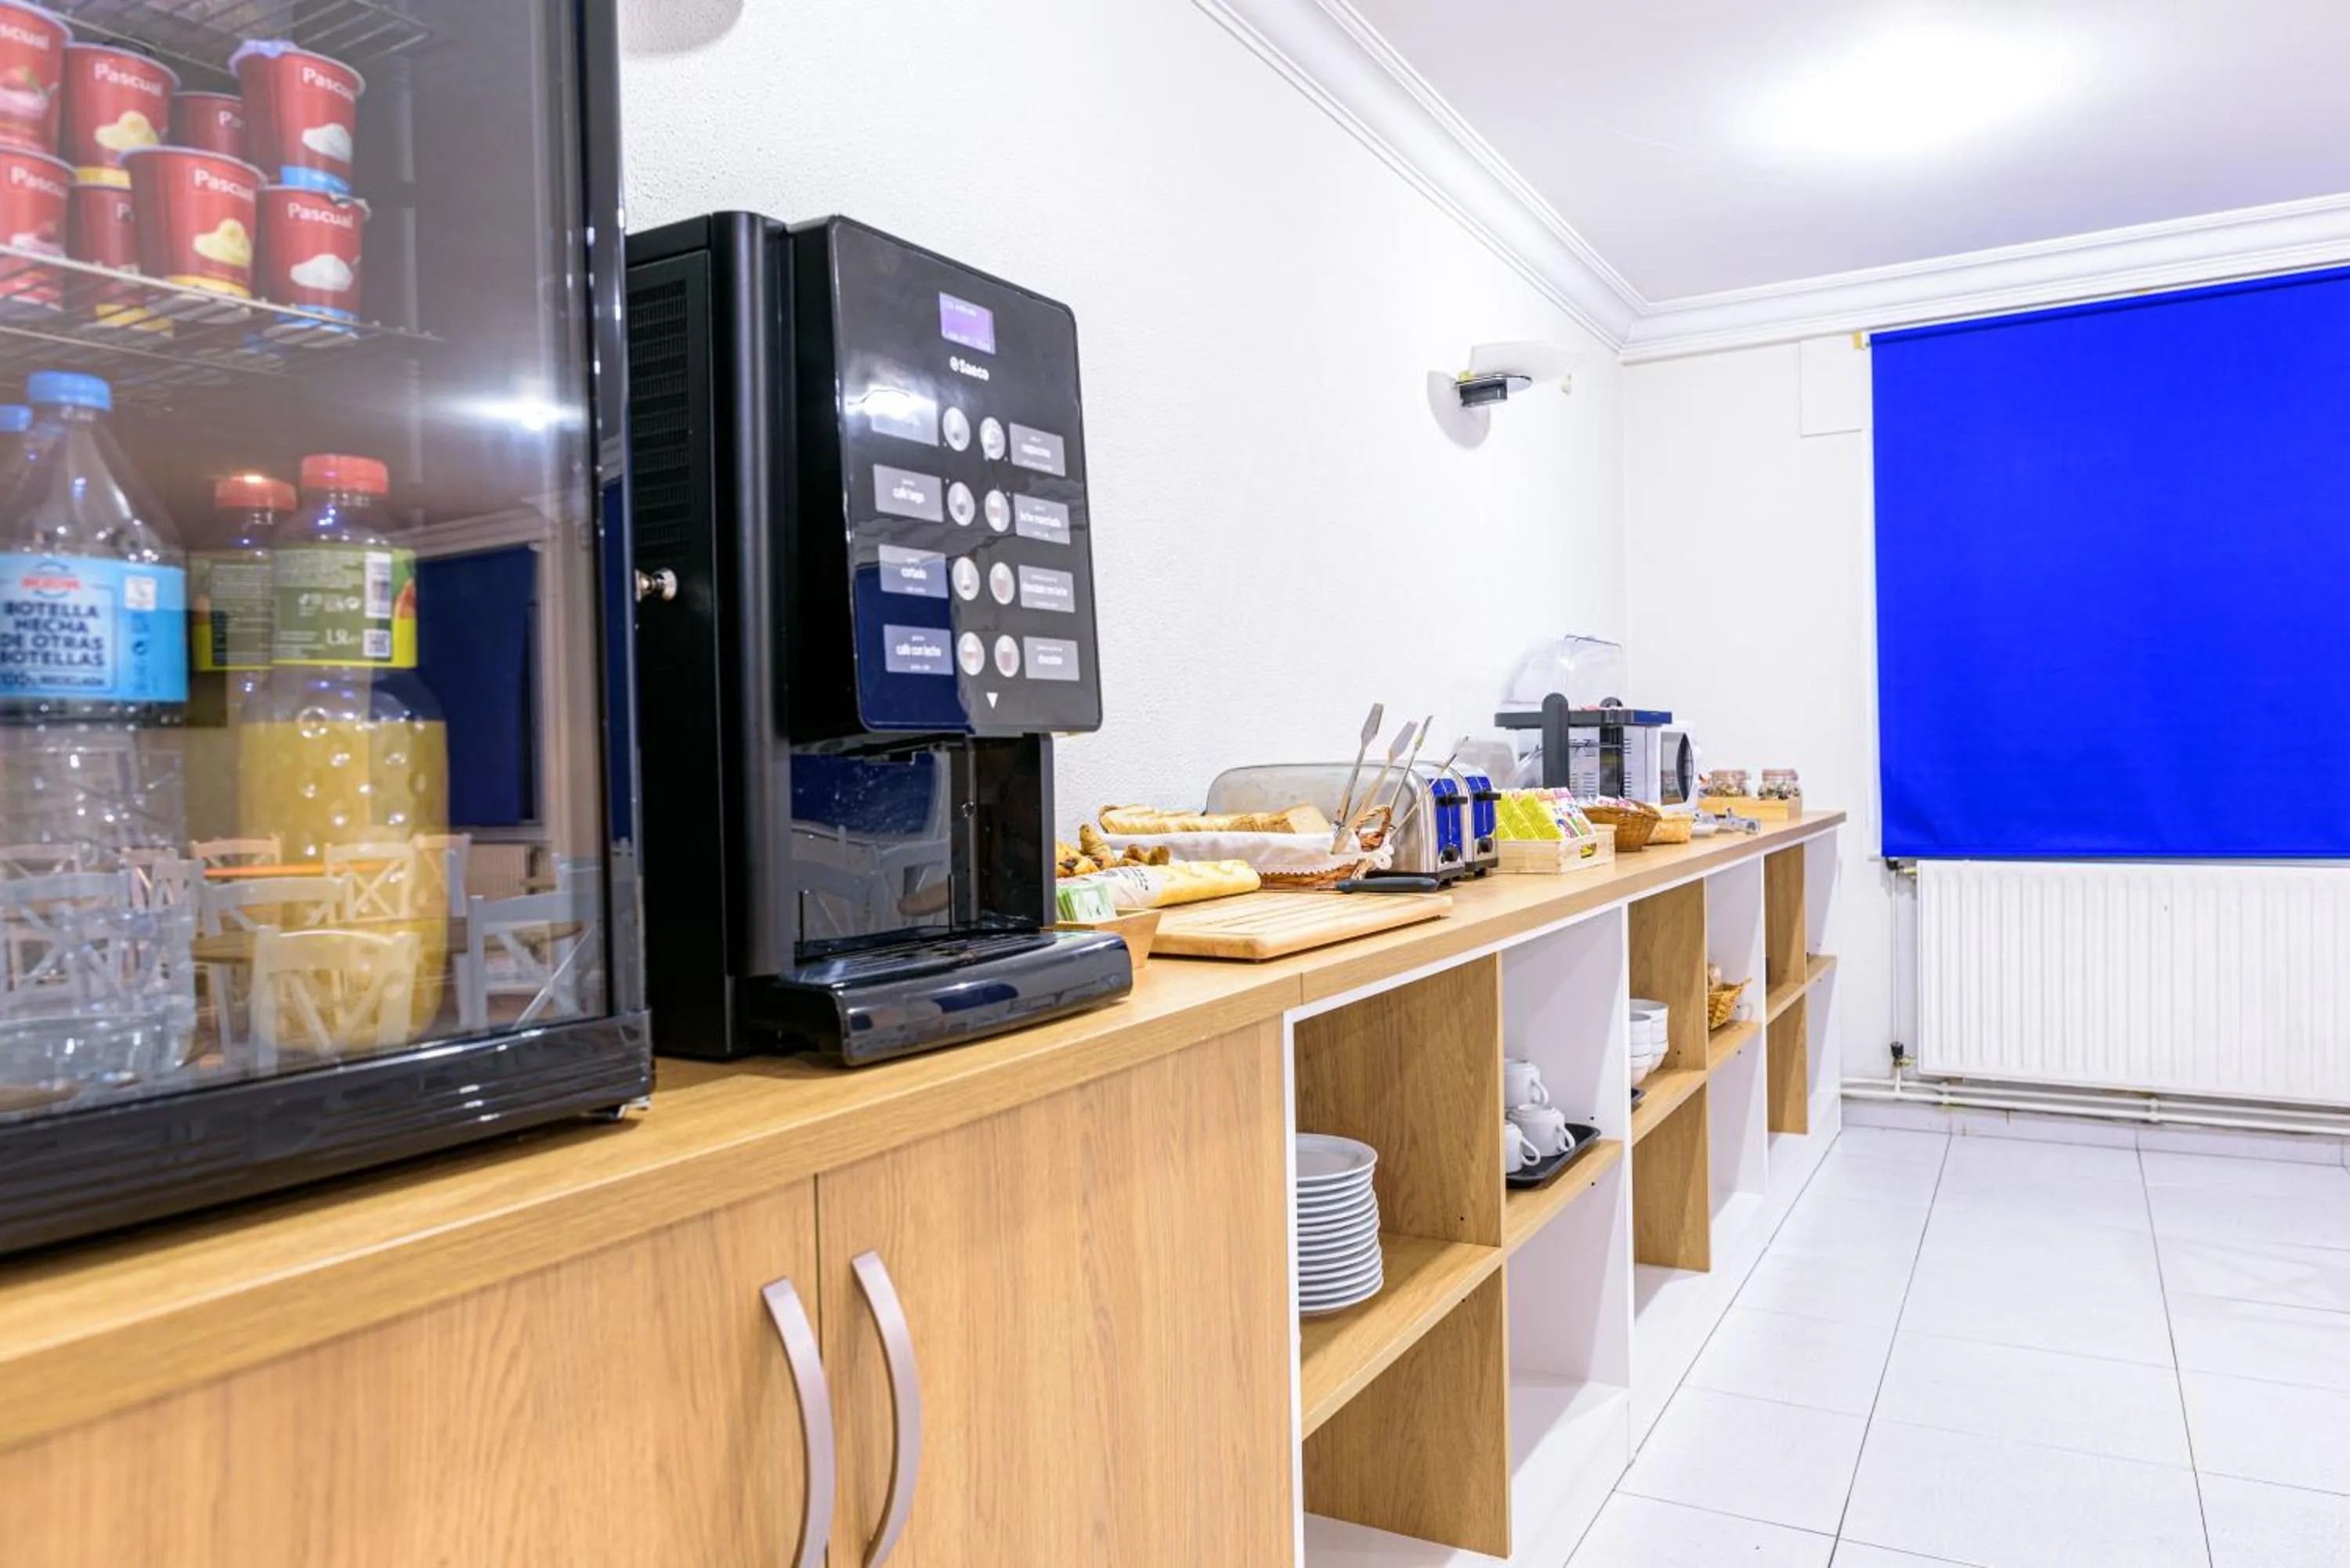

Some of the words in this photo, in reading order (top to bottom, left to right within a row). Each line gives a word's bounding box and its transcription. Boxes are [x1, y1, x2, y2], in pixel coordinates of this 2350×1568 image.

[94, 62, 161, 97] Pascual
[287, 202, 353, 229] Pascual
[3, 601, 101, 619] BOTELLA
[13, 616, 89, 634] HECHA
[0, 633, 24, 648] DE
[31, 634, 106, 651] OTRAS
[0, 650, 106, 667] BOTELLAS
